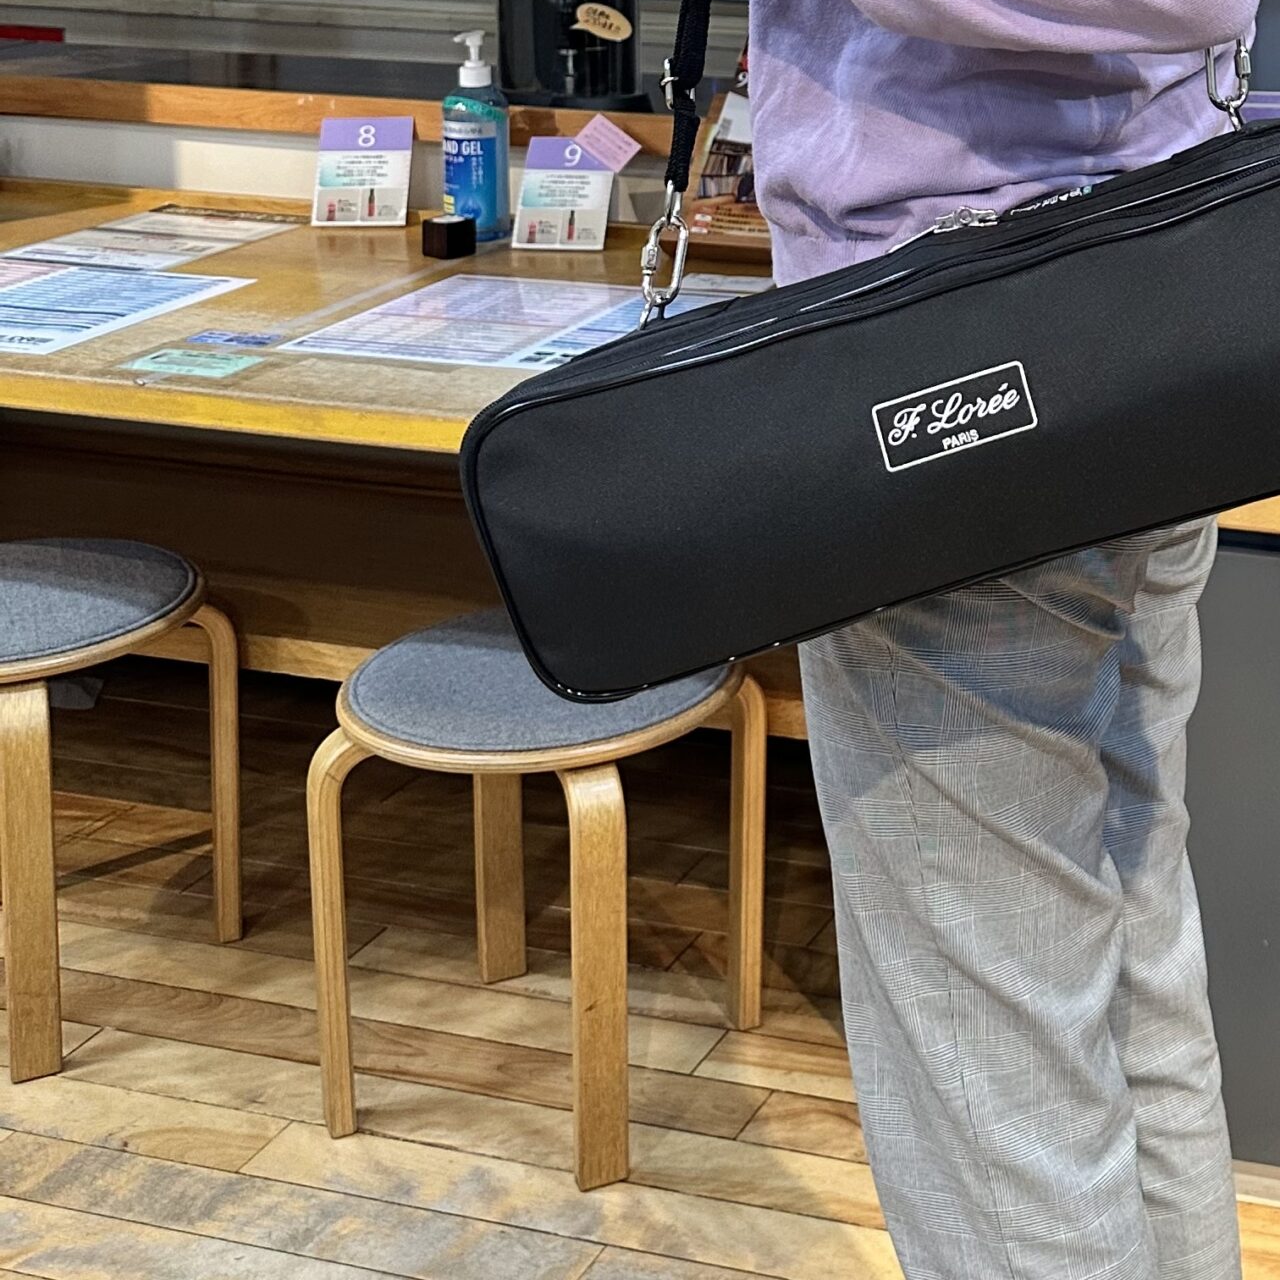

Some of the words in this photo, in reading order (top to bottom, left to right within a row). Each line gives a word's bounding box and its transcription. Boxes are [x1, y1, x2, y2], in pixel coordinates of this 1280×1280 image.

[357, 124, 376, 148] 8
[442, 140, 459, 155] ND
[462, 140, 484, 156] GEL
[563, 143, 582, 167] 9
[888, 403, 926, 446] F.
[926, 382, 1021, 435] Lorée
[942, 429, 980, 451] PARIS
